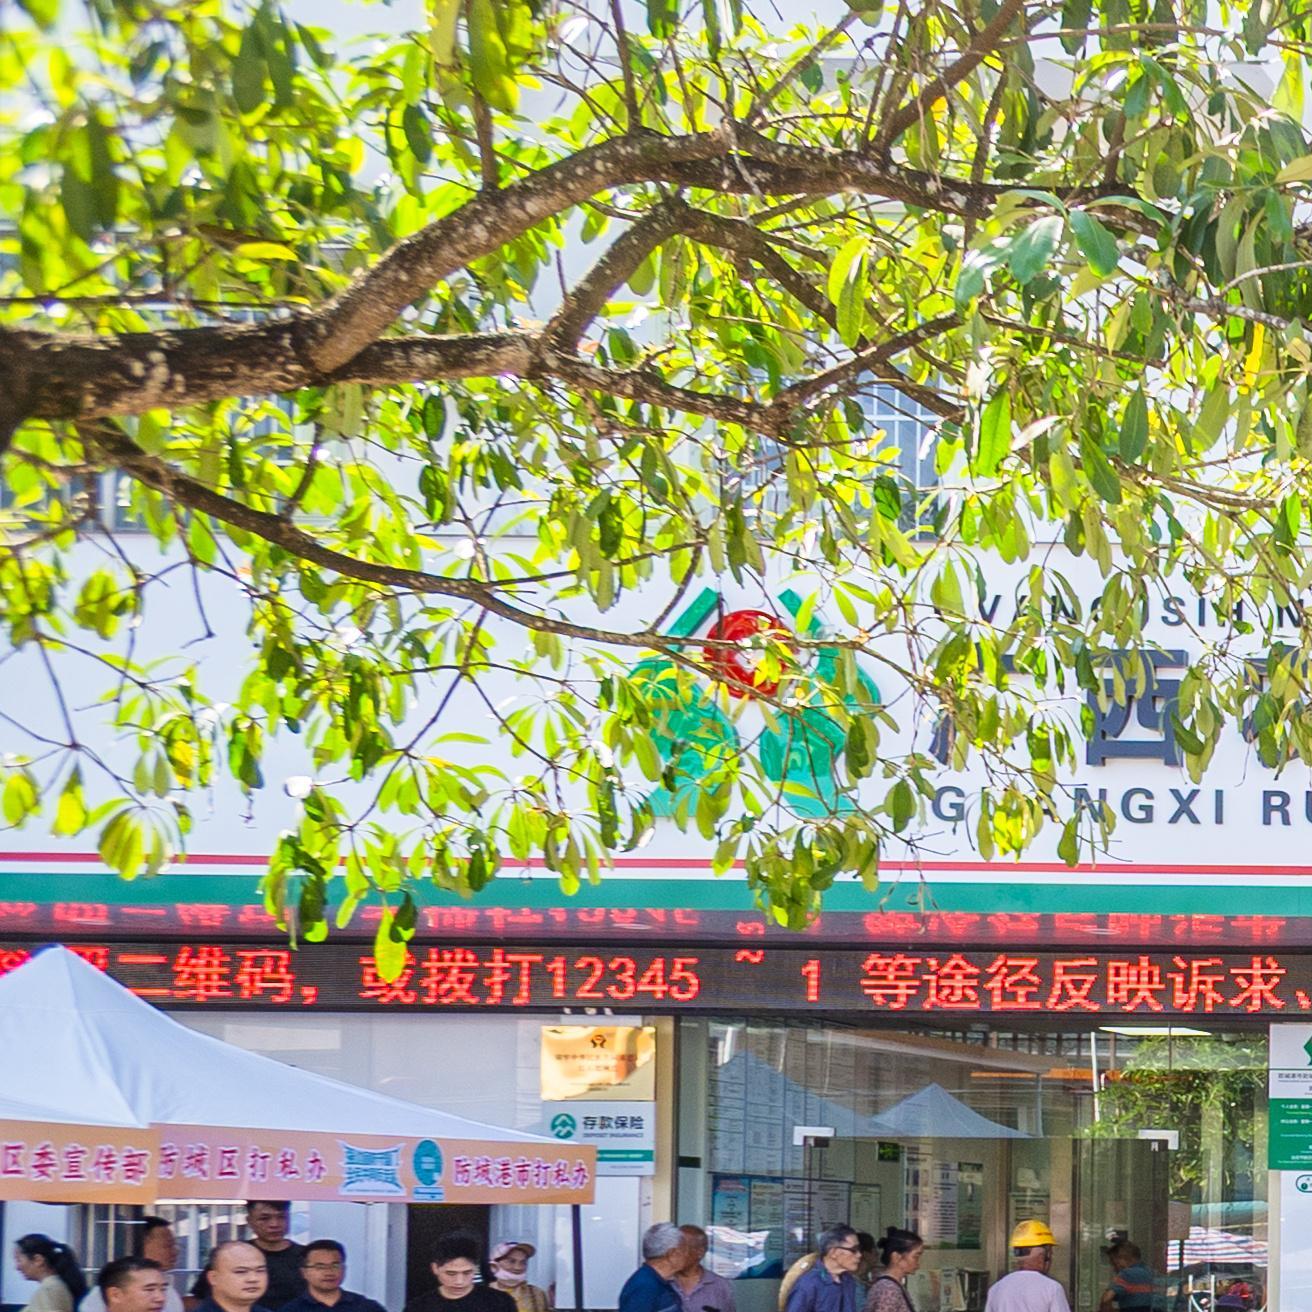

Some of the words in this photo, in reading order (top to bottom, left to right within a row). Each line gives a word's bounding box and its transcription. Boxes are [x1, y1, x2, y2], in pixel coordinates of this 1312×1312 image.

[932, 786, 1224, 825] GNGXI
[582, 1116, 644, 1130] 存款保险
[1, 1143, 149, 1185] 区委宣传部
[453, 1156, 589, 1188] 防城港市打私办
